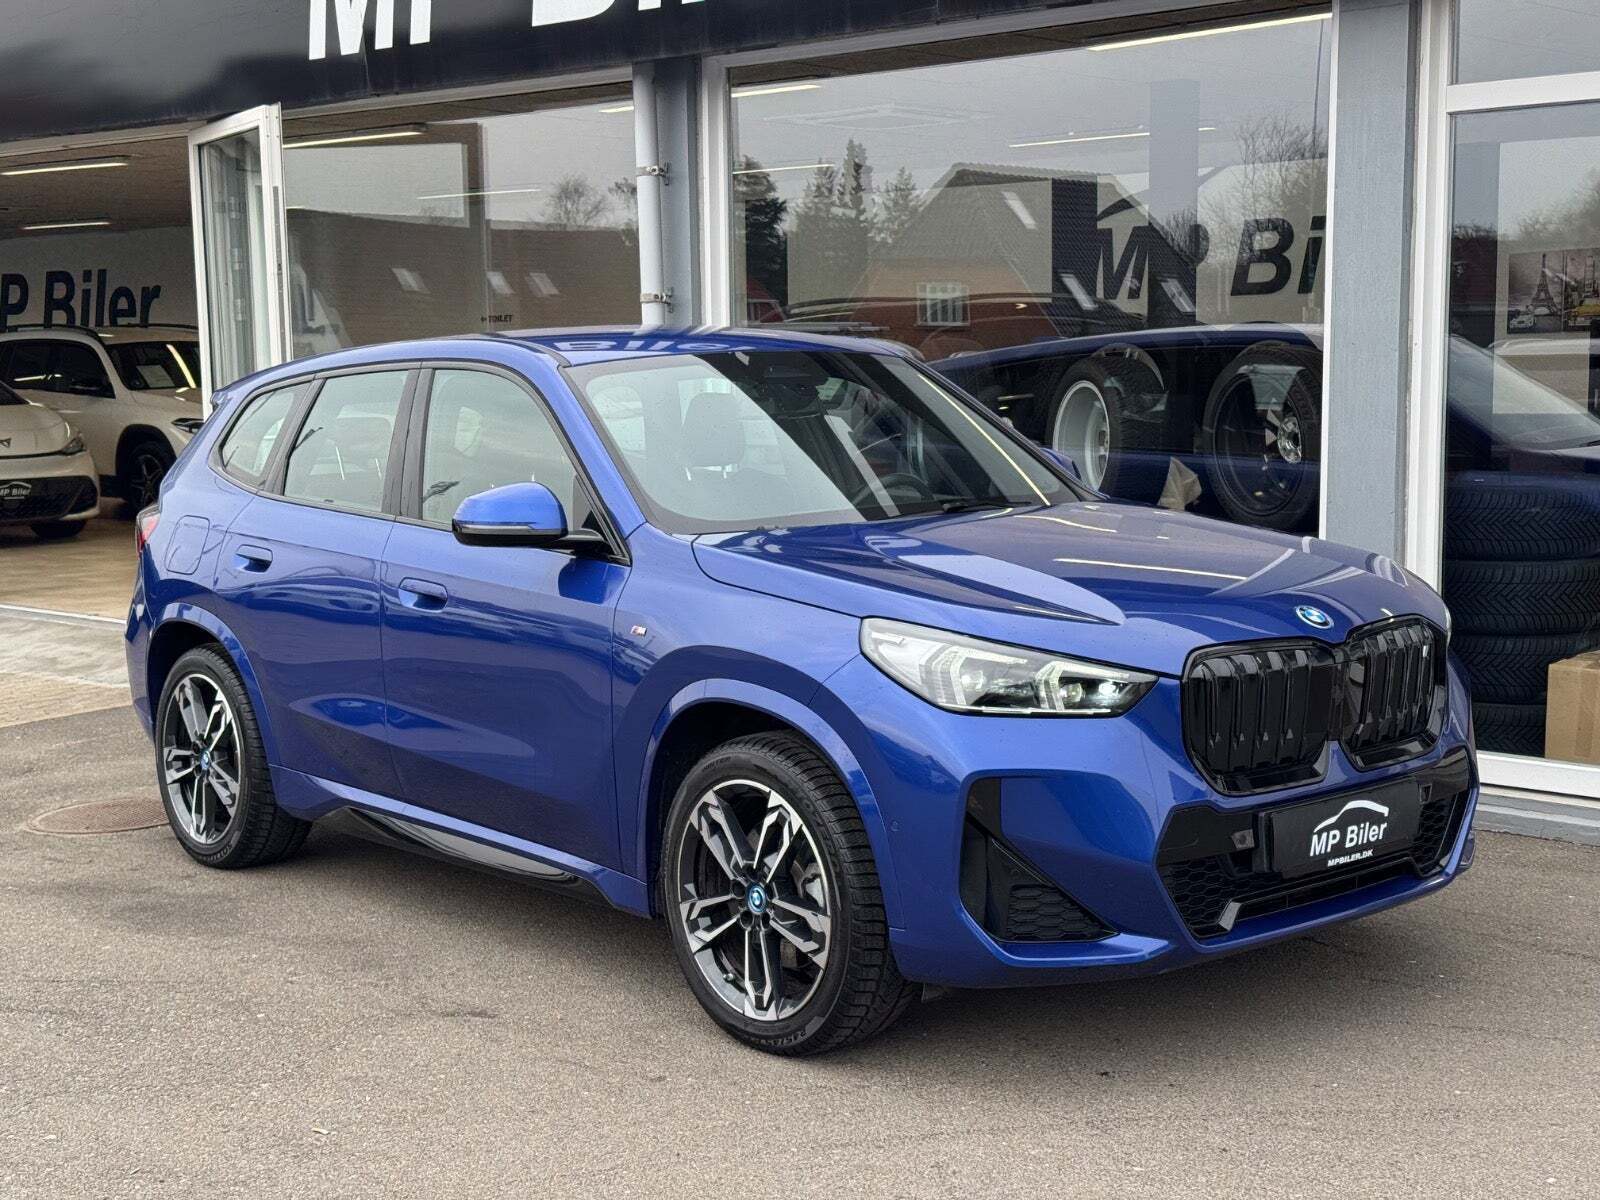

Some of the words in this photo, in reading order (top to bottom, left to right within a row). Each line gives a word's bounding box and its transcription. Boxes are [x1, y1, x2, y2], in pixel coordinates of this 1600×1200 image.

[1230, 215, 1326, 297] Bi
[1309, 829, 1340, 857] MP
[1345, 821, 1388, 848] Biler
[1327, 848, 1373, 867] MPBILER.DK
